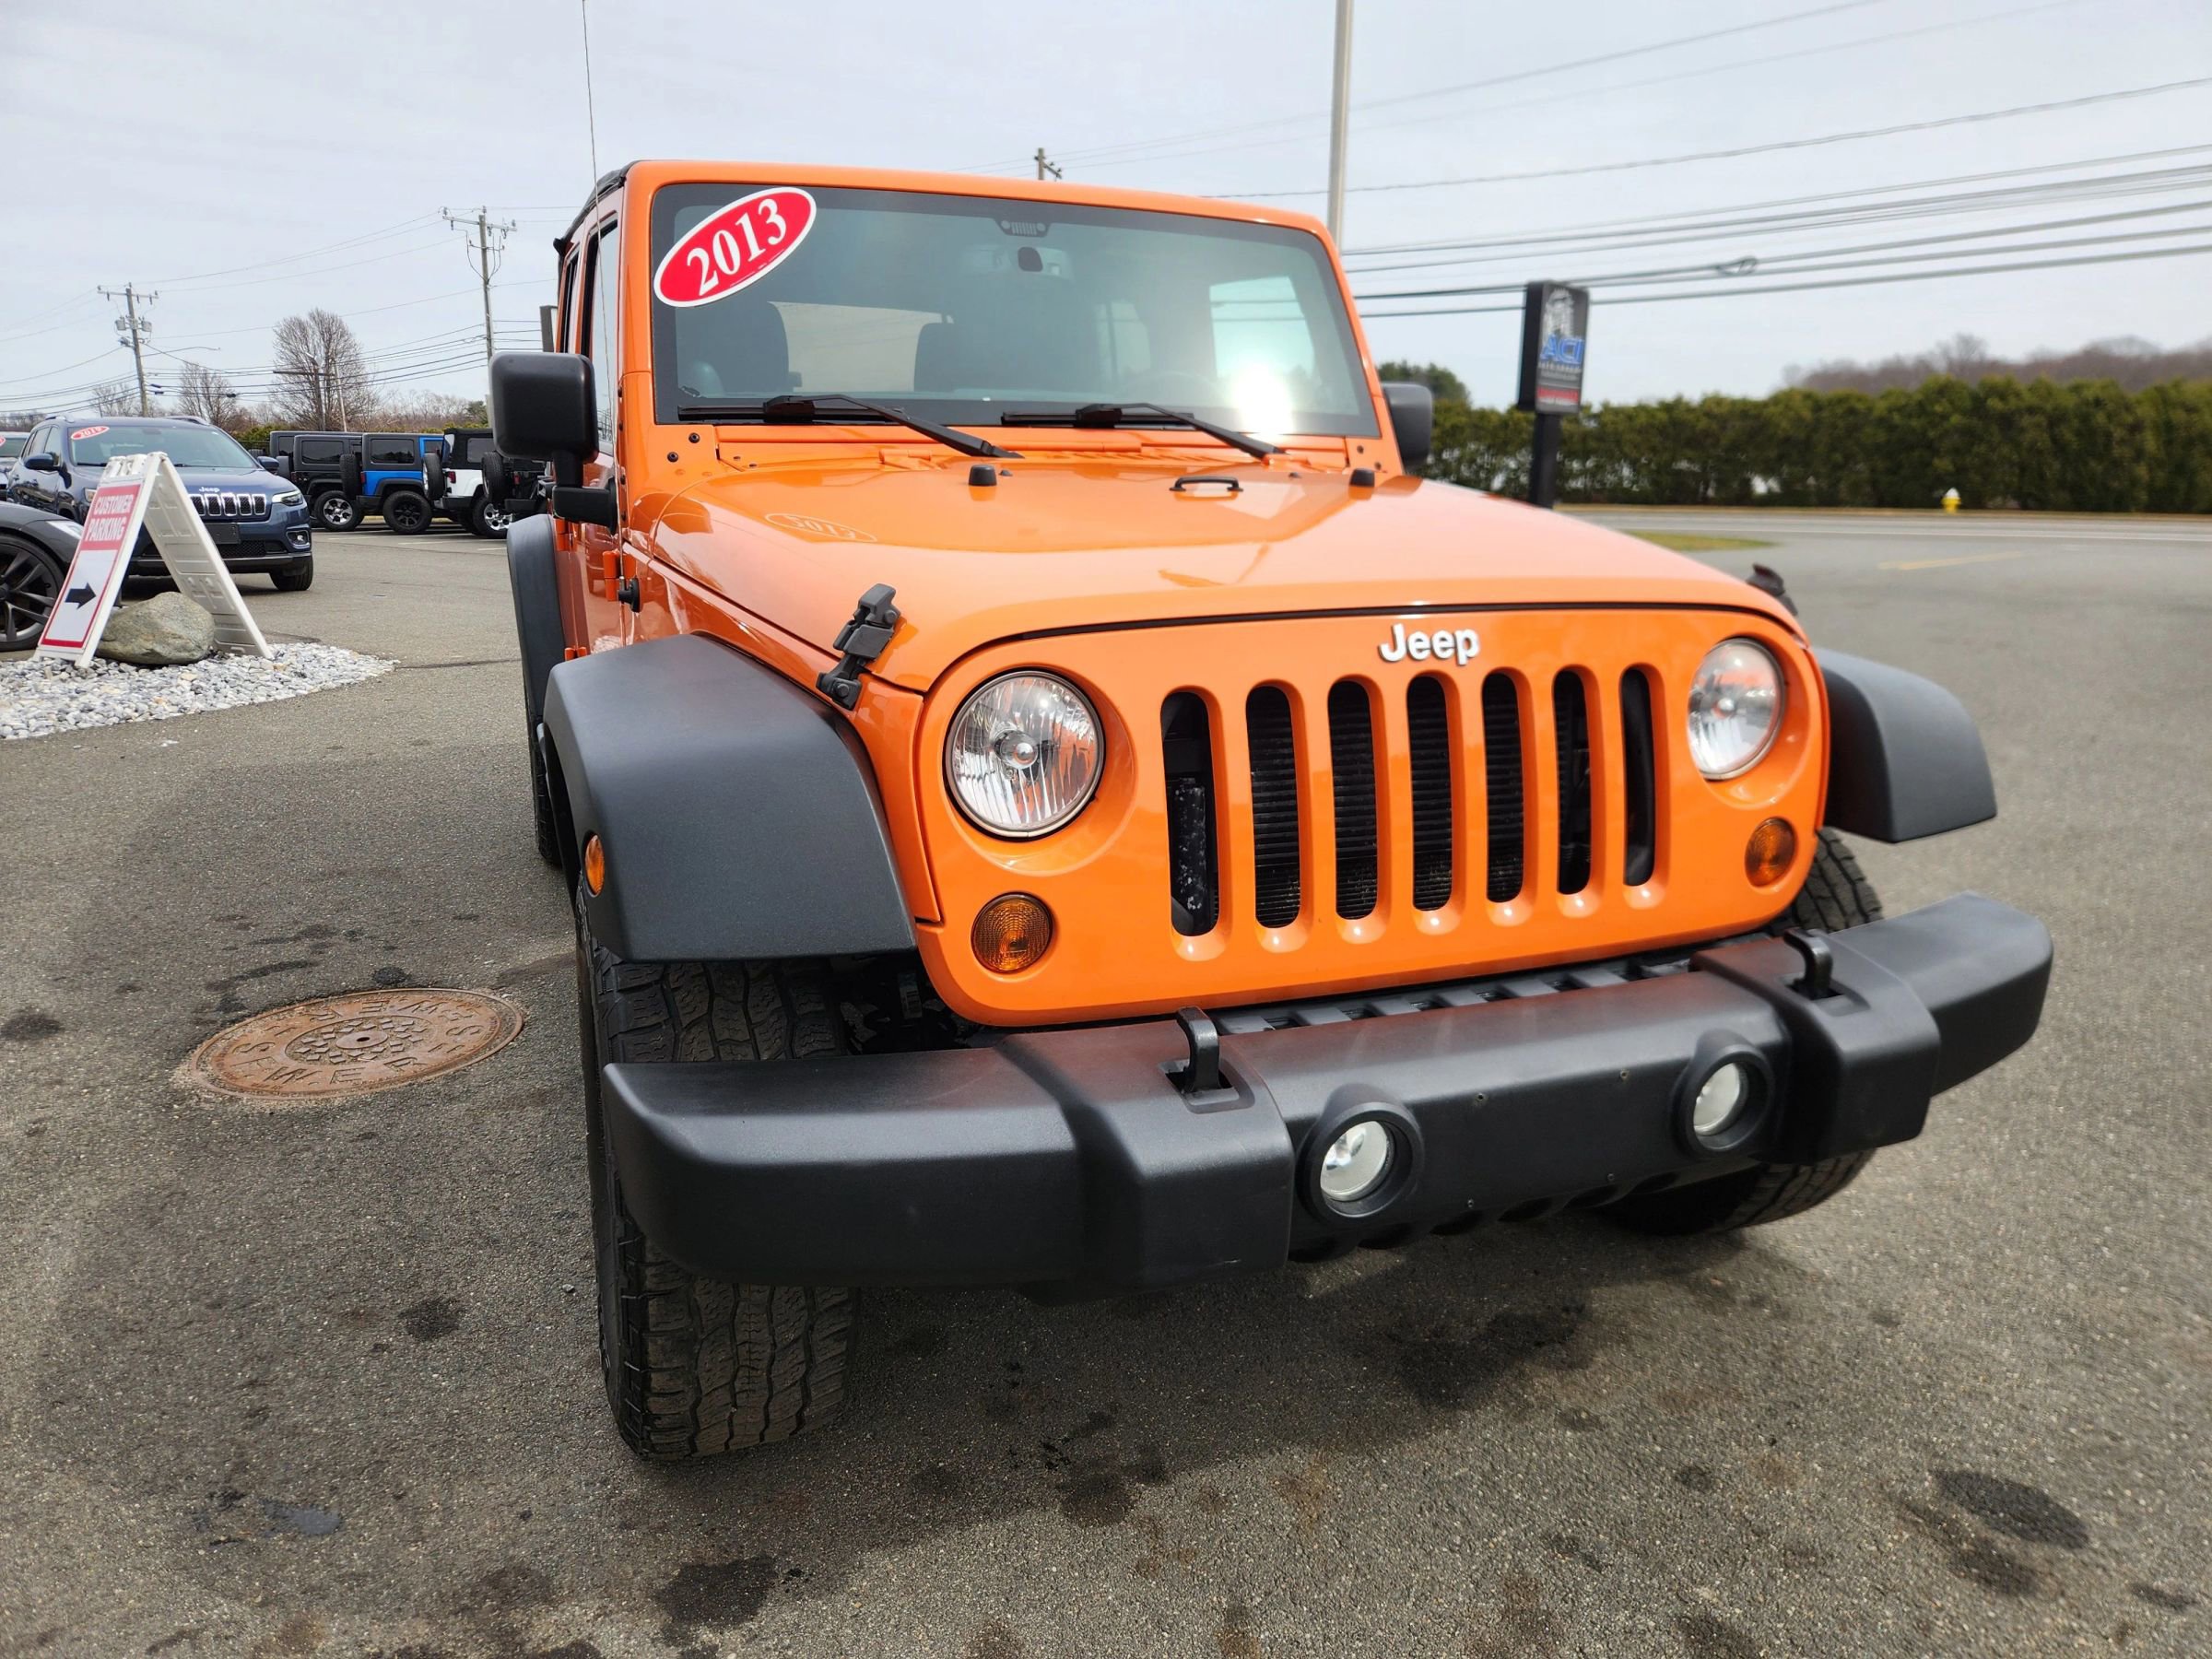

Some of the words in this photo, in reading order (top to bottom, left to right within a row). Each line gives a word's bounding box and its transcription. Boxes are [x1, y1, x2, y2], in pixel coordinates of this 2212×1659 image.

[687, 198, 787, 296] 2013
[93, 494, 135, 515] CUSTOMER
[85, 516, 127, 542] PARKING
[1378, 623, 1480, 665] Jeep
